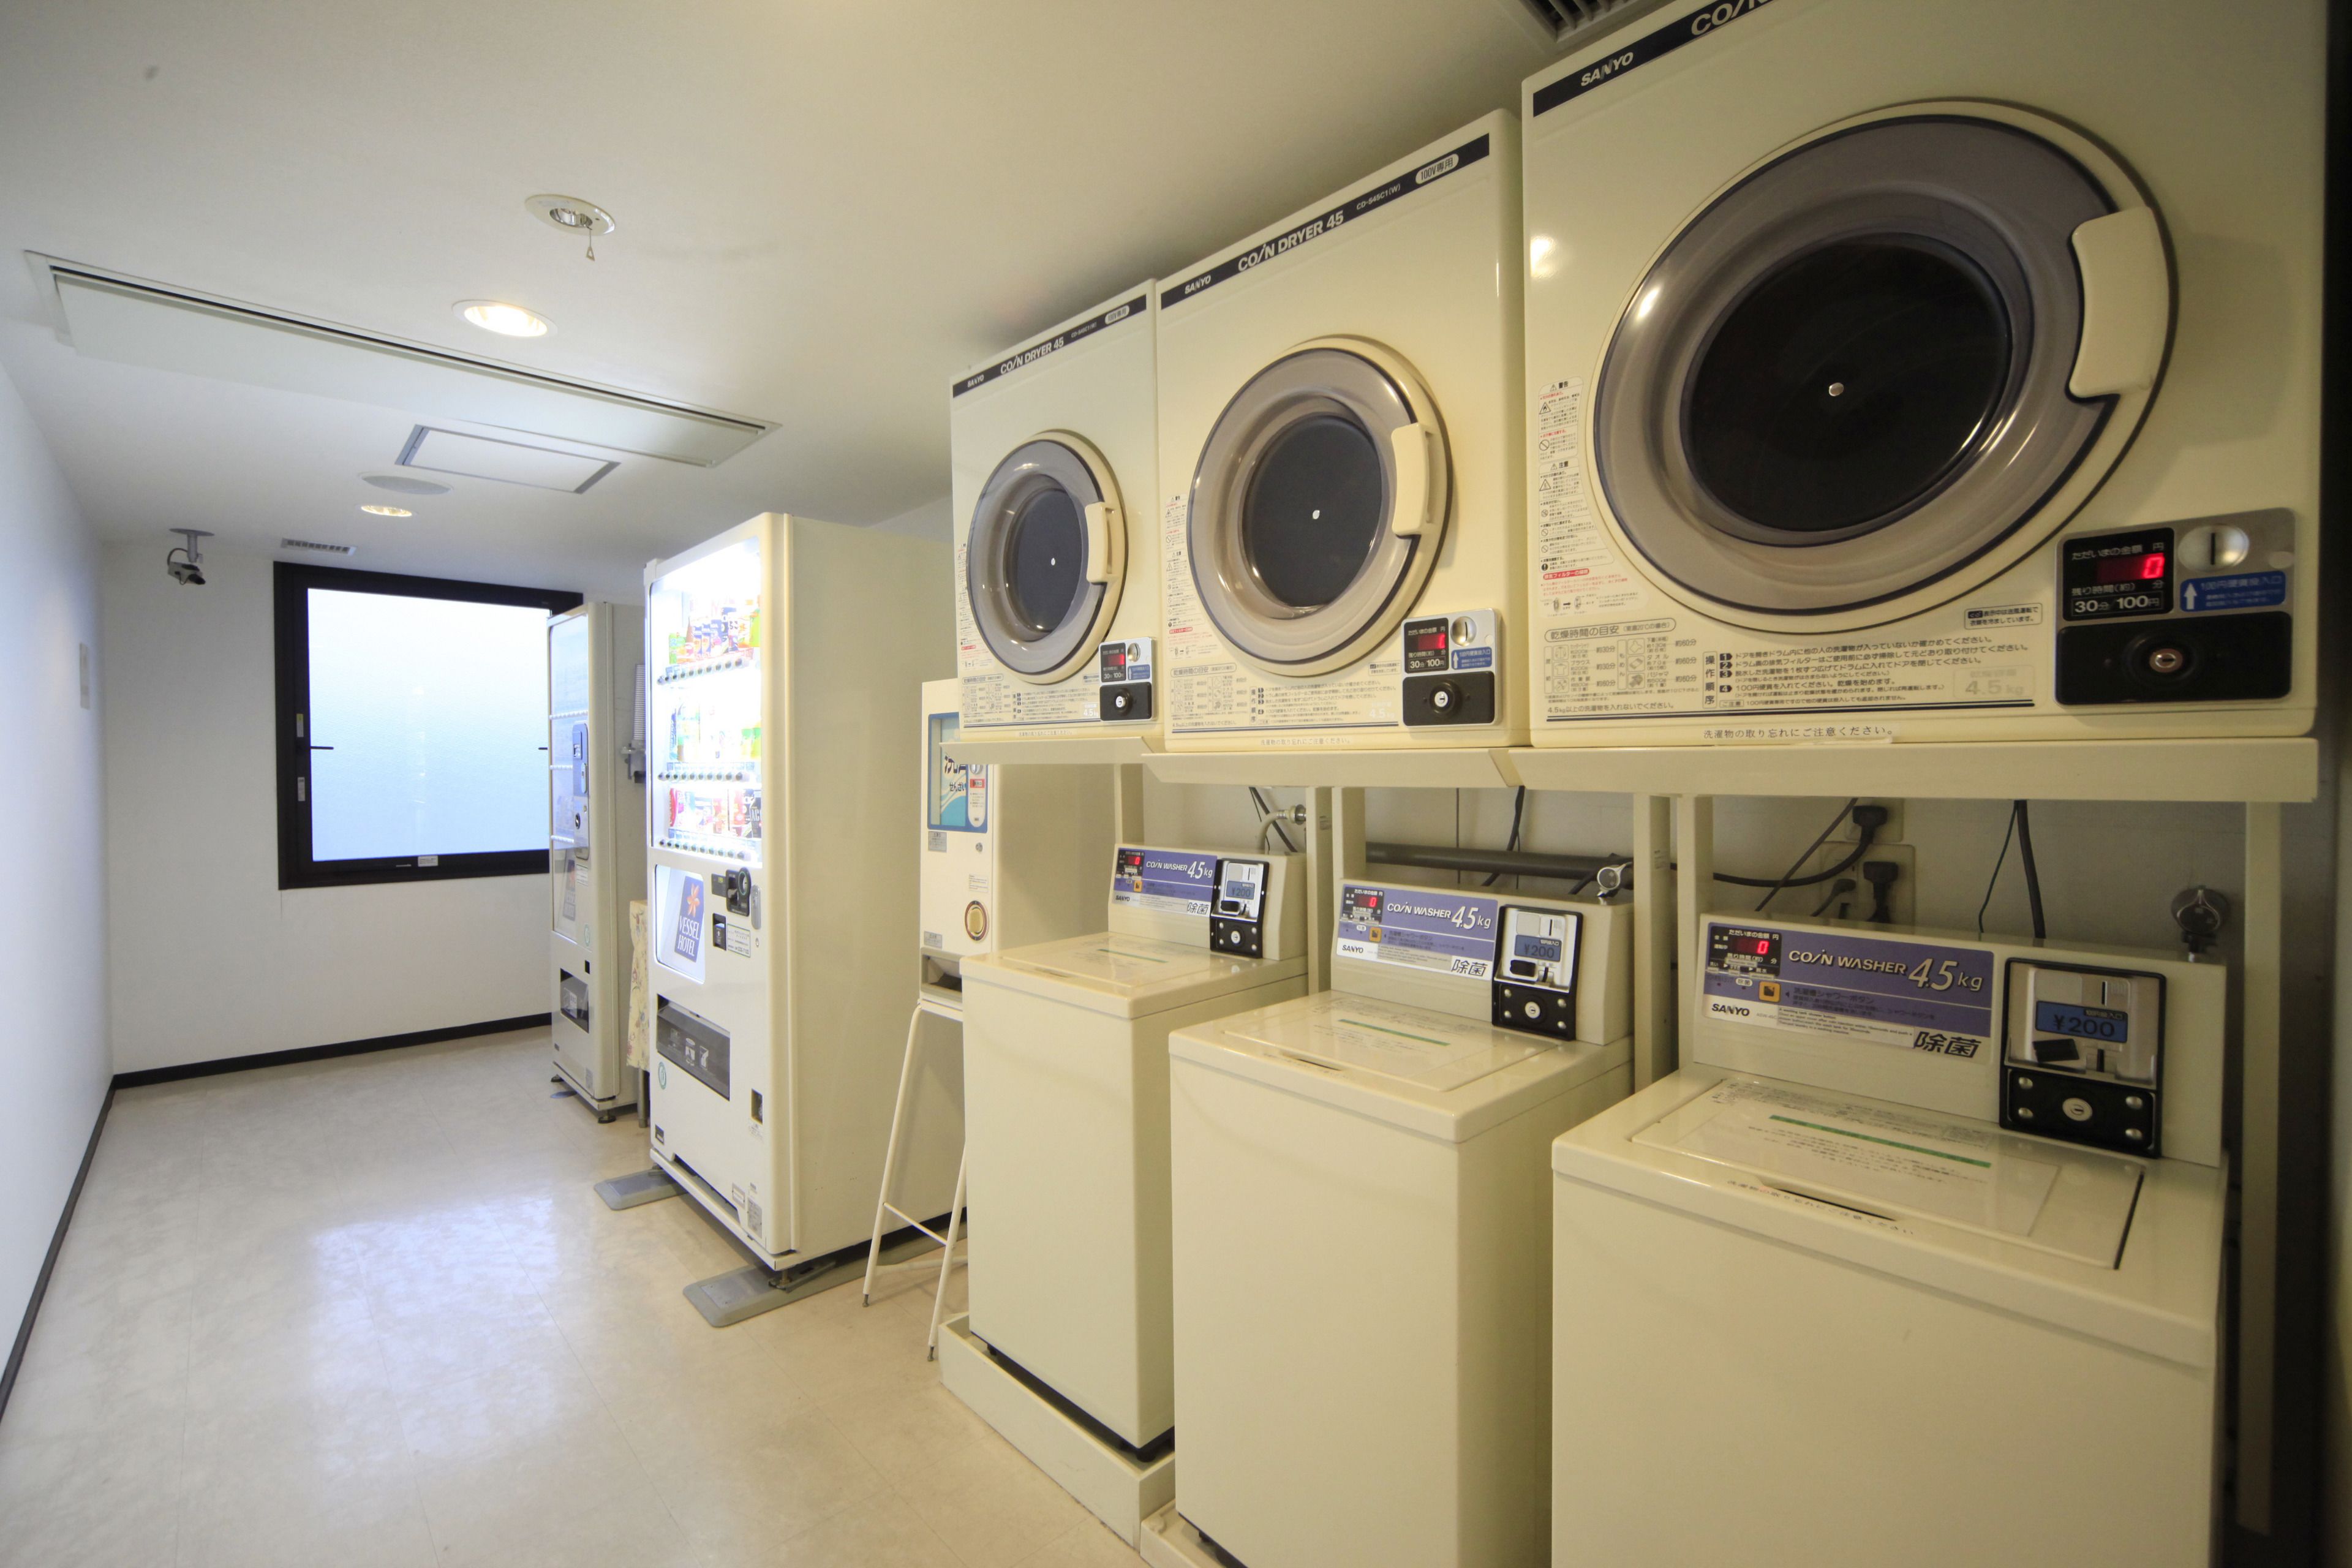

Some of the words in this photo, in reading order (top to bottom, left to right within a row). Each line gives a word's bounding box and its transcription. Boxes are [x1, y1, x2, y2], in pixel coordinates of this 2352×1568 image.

[1580, 51, 1634, 87] SANYO
[1184, 274, 1212, 295] SANYO
[1278, 220, 1324, 254] DRYER
[1326, 210, 1344, 228] 45
[1025, 342, 1052, 363] DRYER
[1053, 336, 1064, 350] 45
[2152, 542, 2165, 551] 円
[2143, 552, 2165, 579] 0
[1550, 624, 1619, 640] 乾燥時間の目安
[1703, 726, 1893, 739] 洗濯物の取り忘れにご注意ください。
[1164, 862, 1188, 872] WASHER
[1370, 897, 1378, 907] 0
[1414, 907, 1452, 919] WASHER
[679, 916, 699, 940] VESSEL
[677, 934, 695, 957] HOTEL
[1341, 944, 1364, 954] SANYO
[1524, 944, 1555, 958] ¥200
[1757, 941, 1770, 954] 0
[1450, 959, 1488, 976] 除菌
[1837, 956, 1907, 975] WASHER
[1711, 1003, 1751, 1017] SANYO
[2053, 1014, 2115, 1037] ¥200
[1913, 1031, 1982, 1058] 除菌
